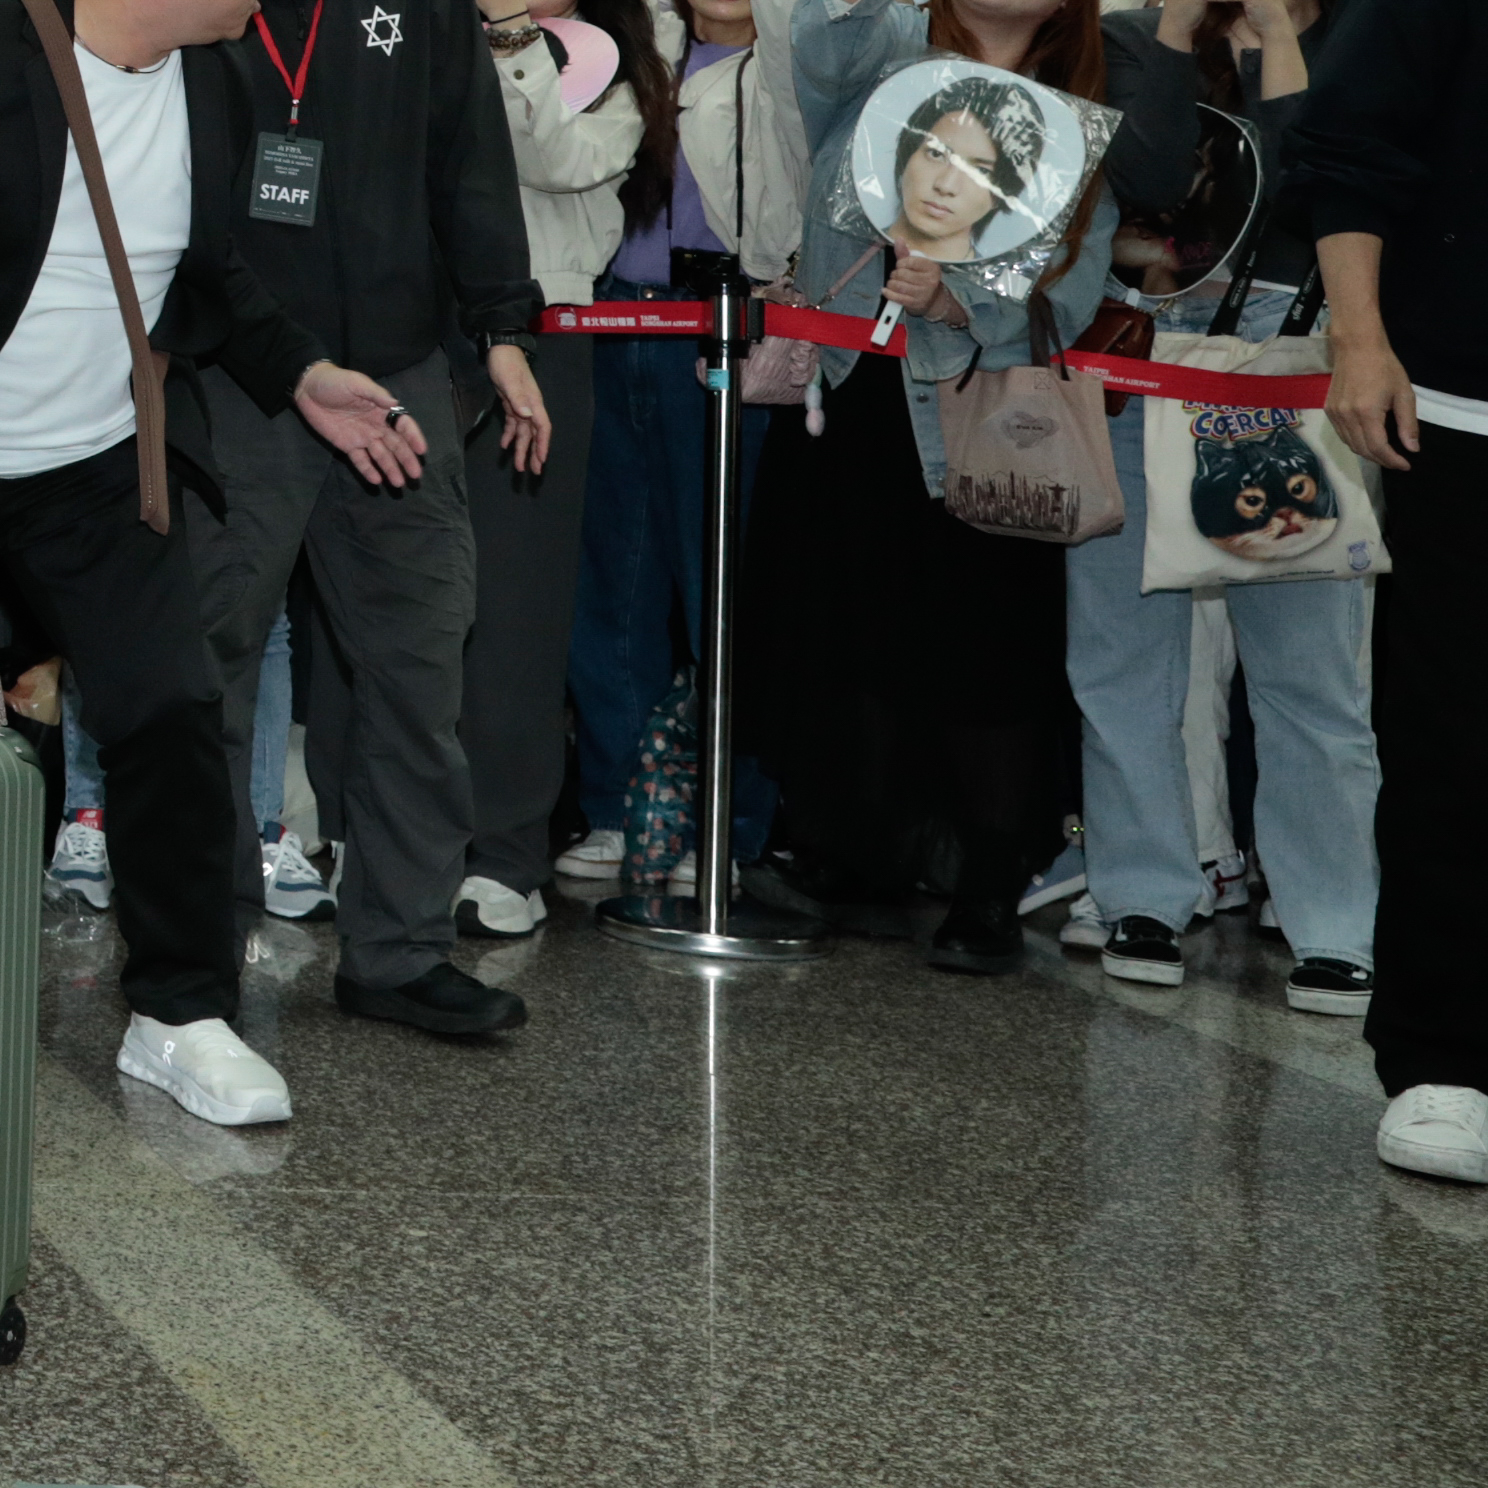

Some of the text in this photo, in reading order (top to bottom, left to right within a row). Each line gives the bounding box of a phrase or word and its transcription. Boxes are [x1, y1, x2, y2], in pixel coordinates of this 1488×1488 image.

[259, 183, 310, 205] STAFF
[1084, 365, 1110, 375] TAIPEI
[1125, 378, 1161, 389] AIRPORT
